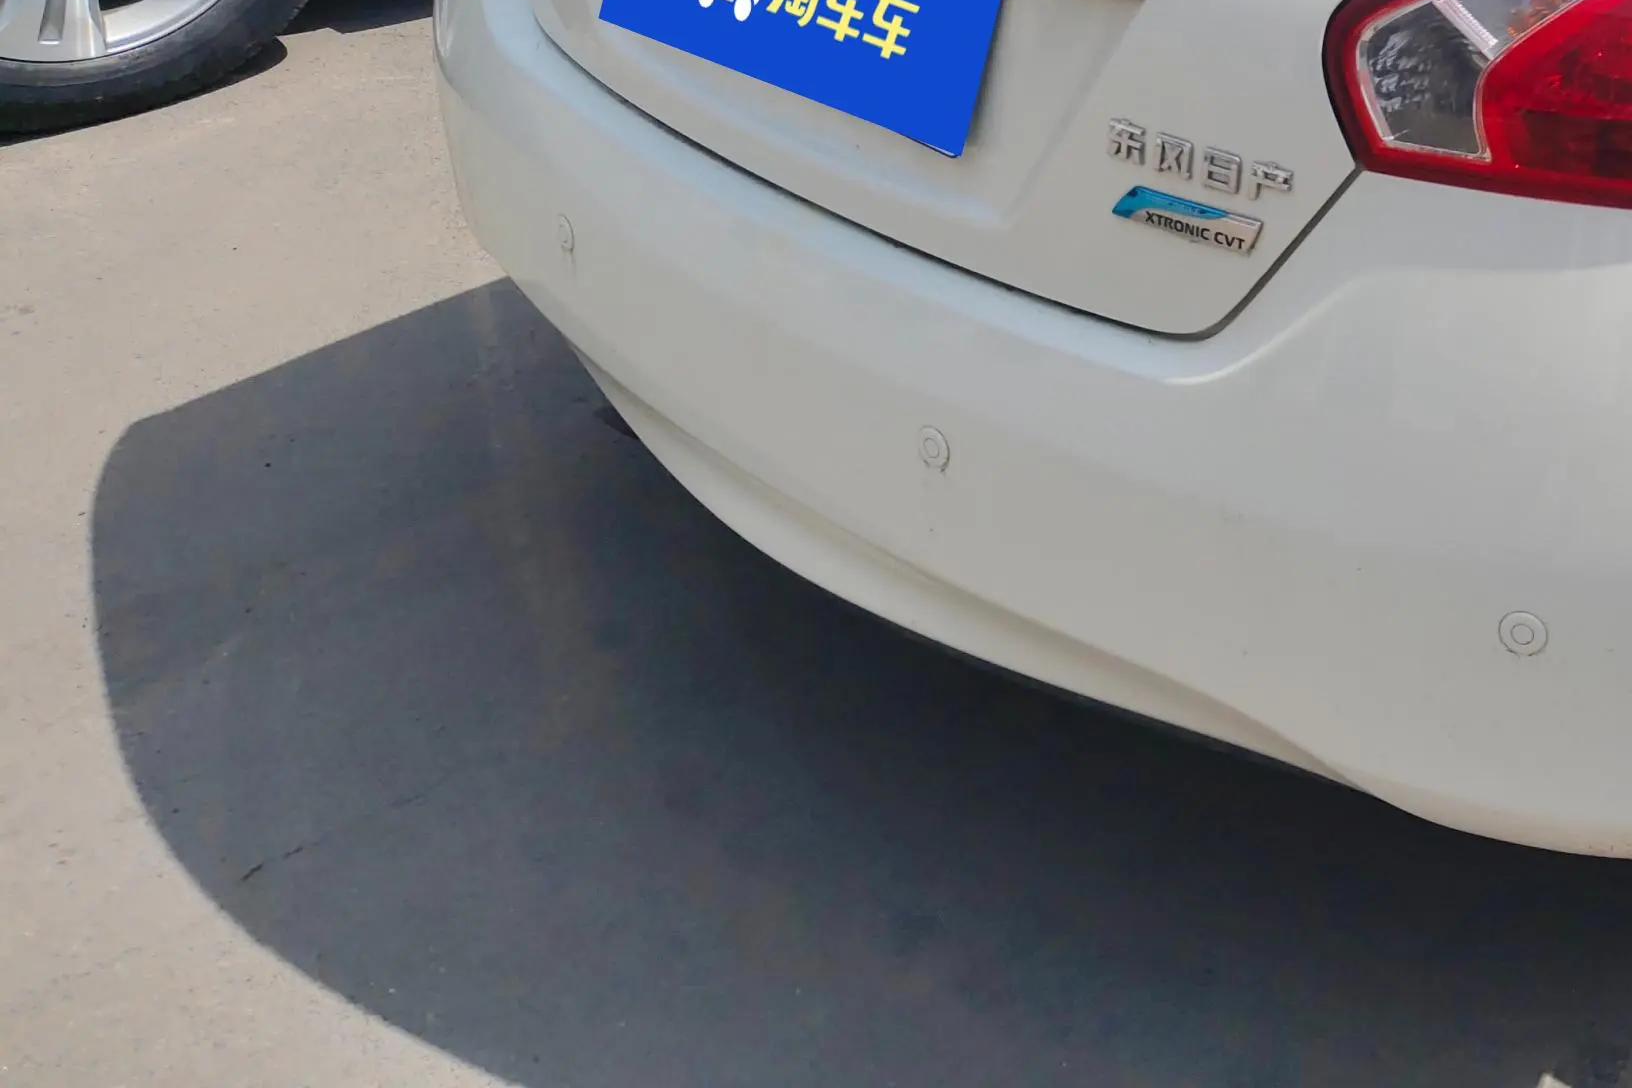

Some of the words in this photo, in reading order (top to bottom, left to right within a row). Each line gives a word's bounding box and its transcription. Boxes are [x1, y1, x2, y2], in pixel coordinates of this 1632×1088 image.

[1108, 118, 1294, 201] 东风日产
[1143, 211, 1210, 241] XTRONIC
[1213, 231, 1246, 250] CVT
